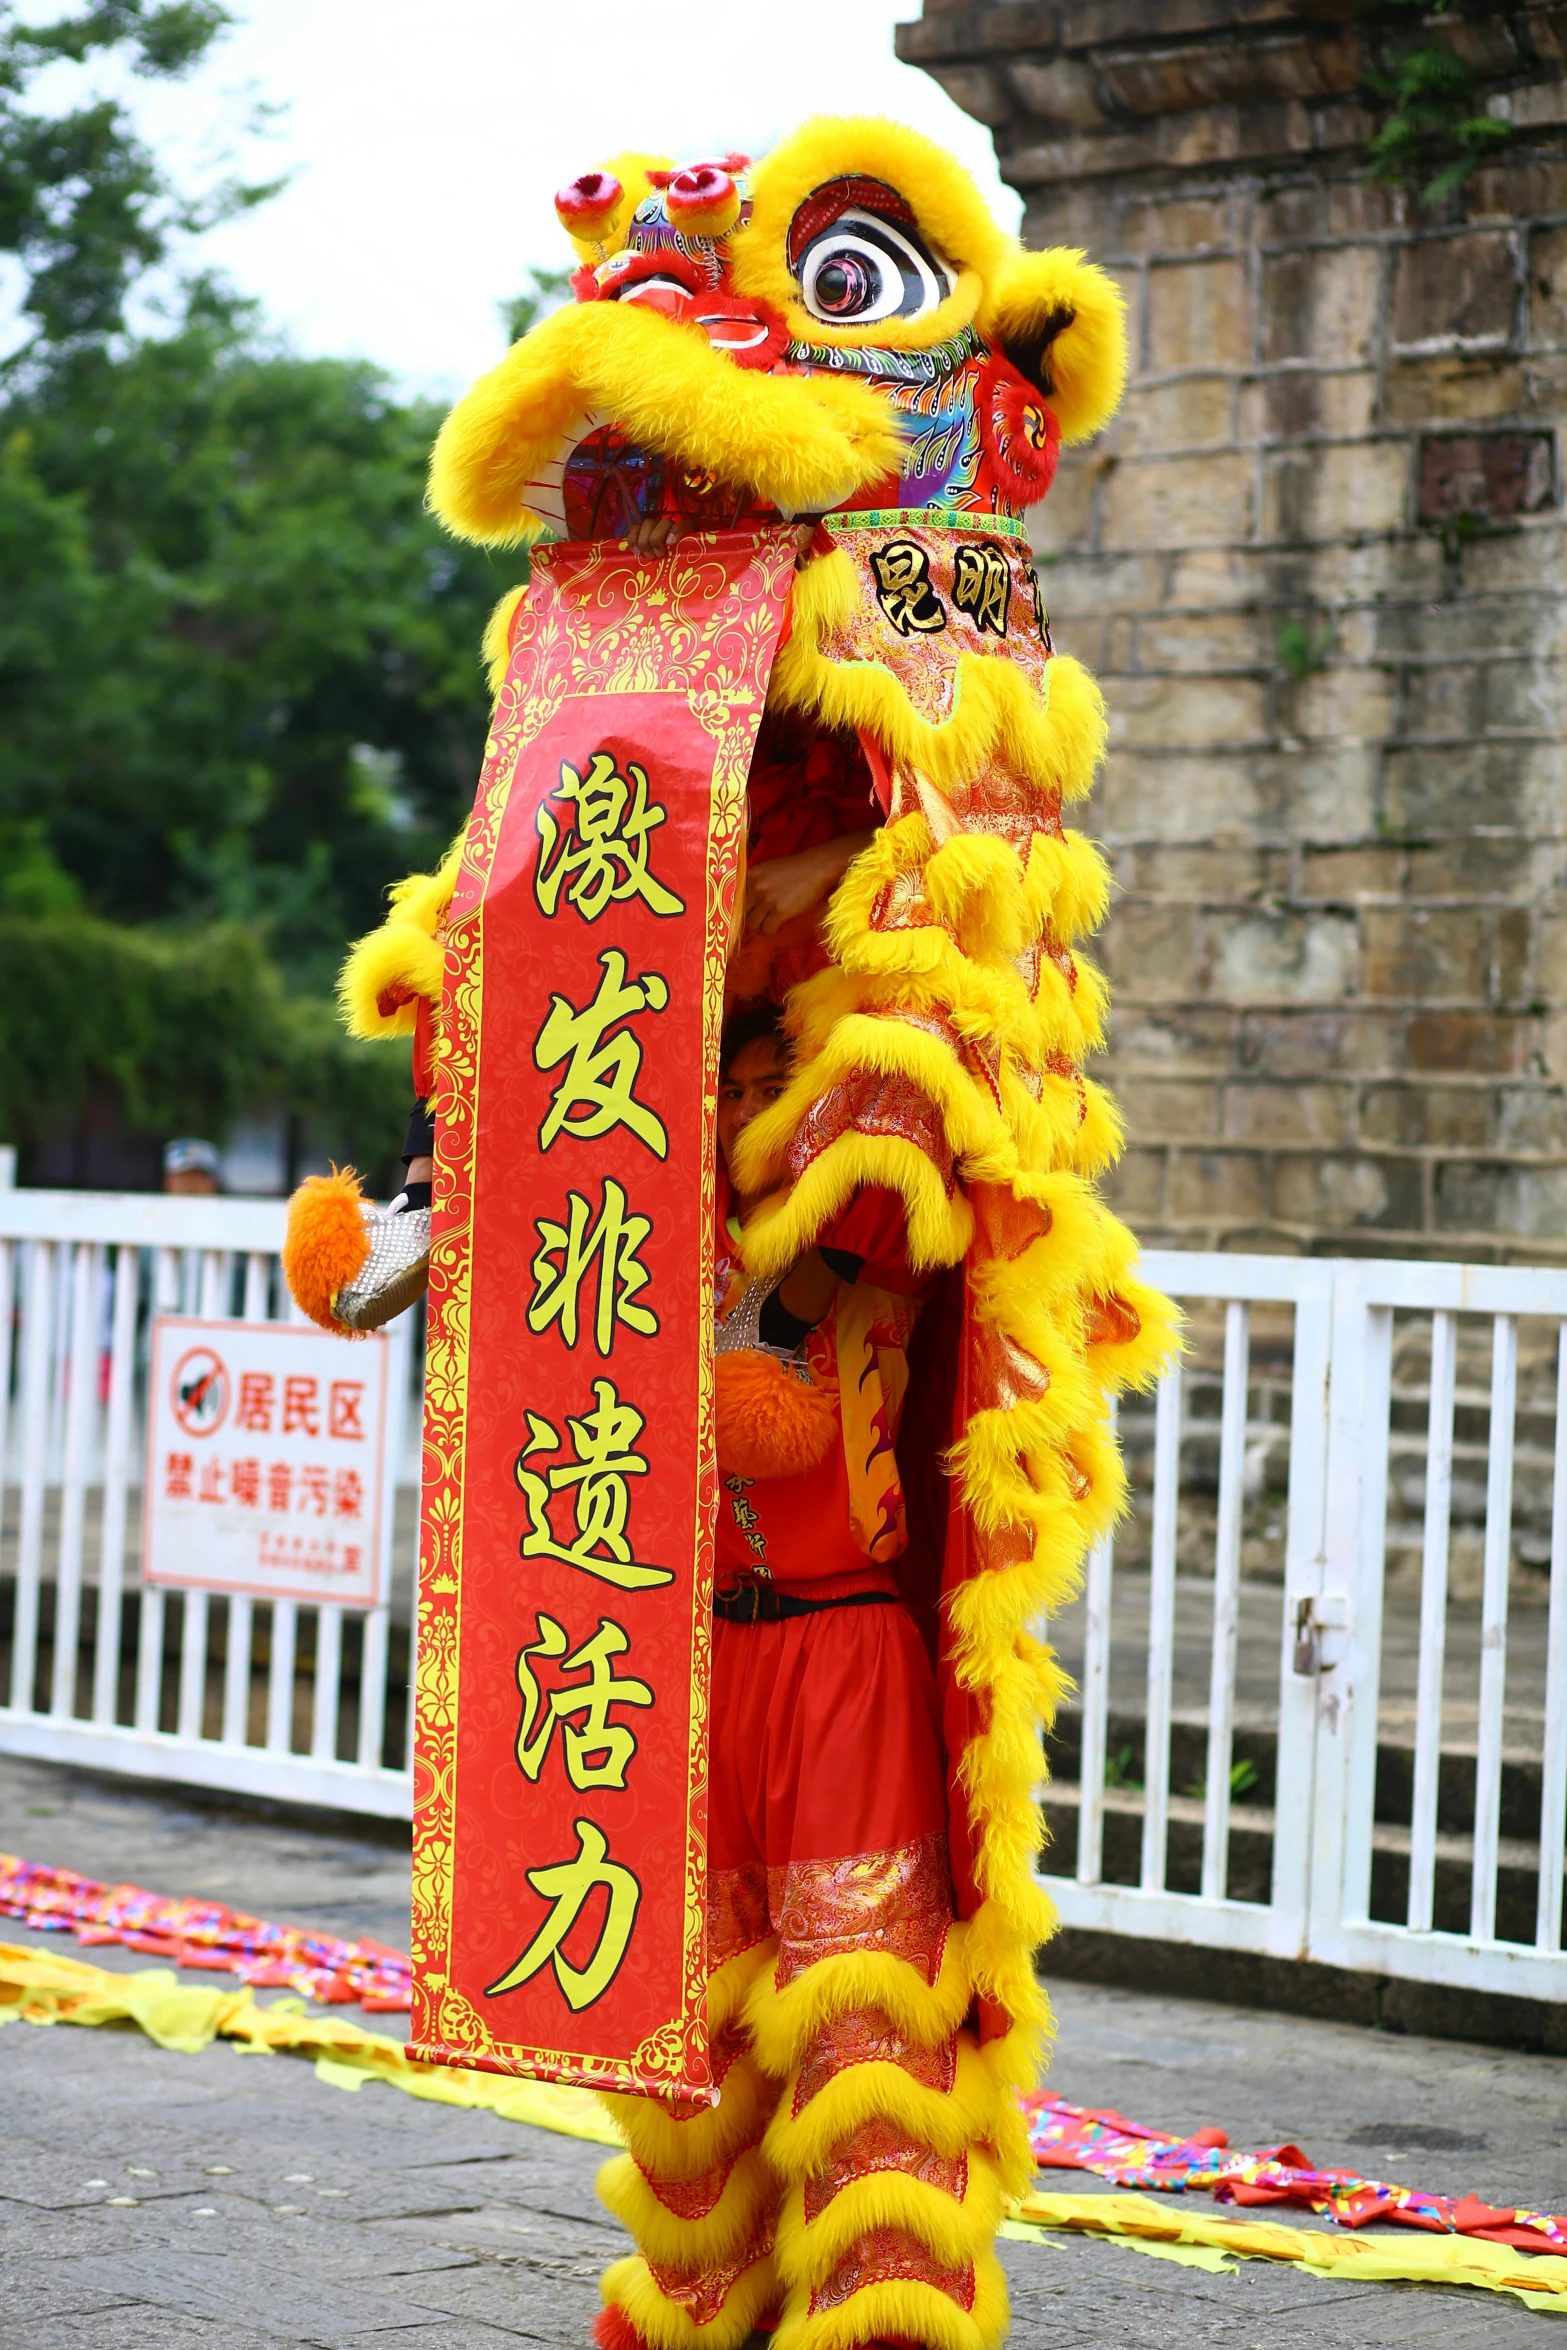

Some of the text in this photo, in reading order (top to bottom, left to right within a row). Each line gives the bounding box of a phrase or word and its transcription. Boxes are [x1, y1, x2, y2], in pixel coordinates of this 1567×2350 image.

[235, 1372, 366, 1441] 居民区
[486, 751, 686, 2012] 激发非遗活力
[165, 1452, 363, 1519] 禁止噪音污染
